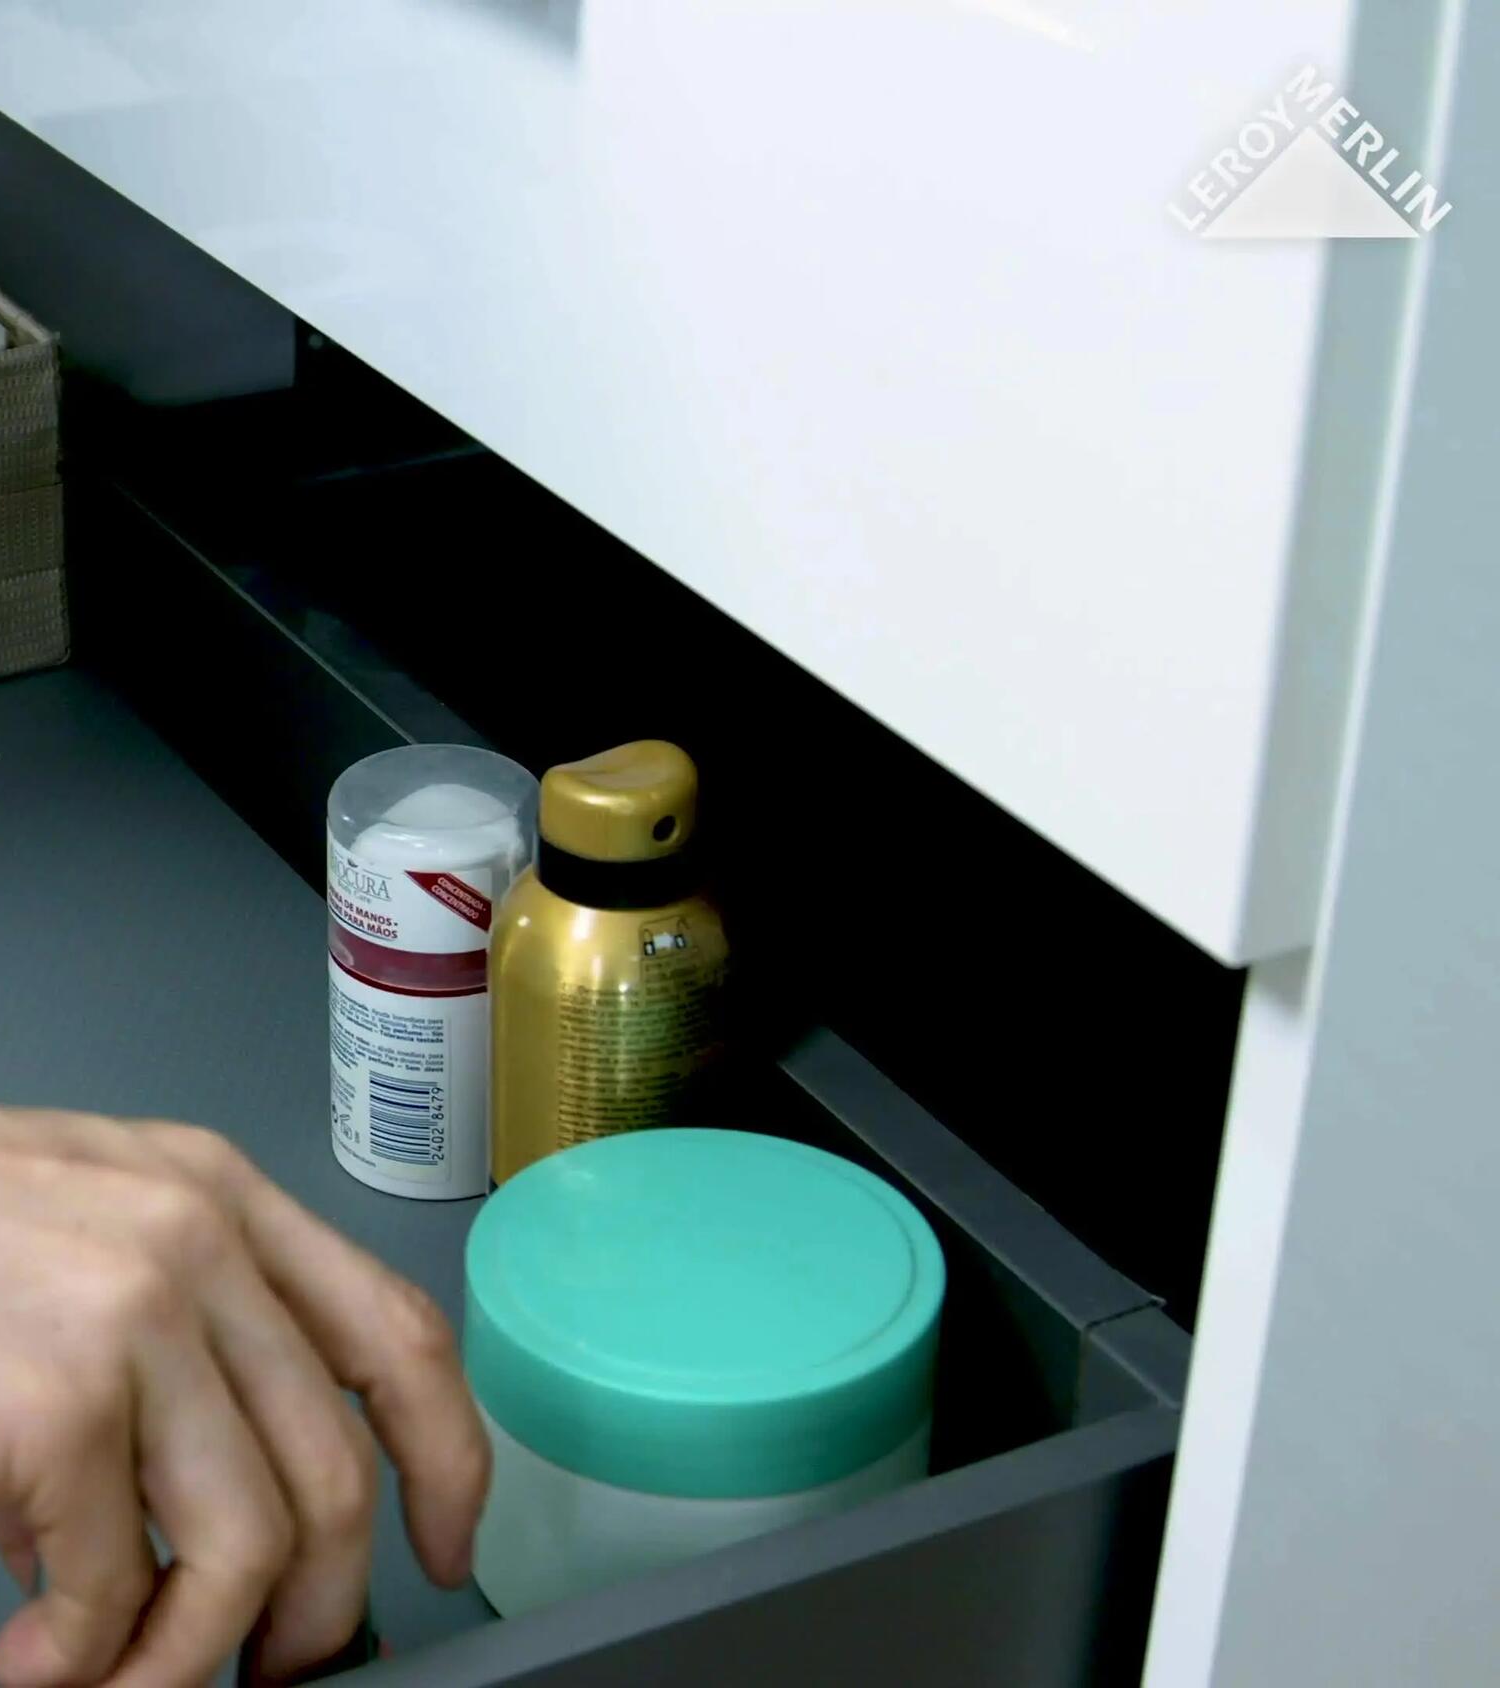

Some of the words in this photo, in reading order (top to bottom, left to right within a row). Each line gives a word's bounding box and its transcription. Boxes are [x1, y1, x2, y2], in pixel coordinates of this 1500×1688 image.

[344, 899, 354, 912] DE
[356, 906, 393, 927] MANOS
[344, 910, 365, 930] PARA
[367, 922, 398, 939] MÃOS
[431, 1086, 444, 1120] 8479
[431, 1128, 444, 1161] 2402
